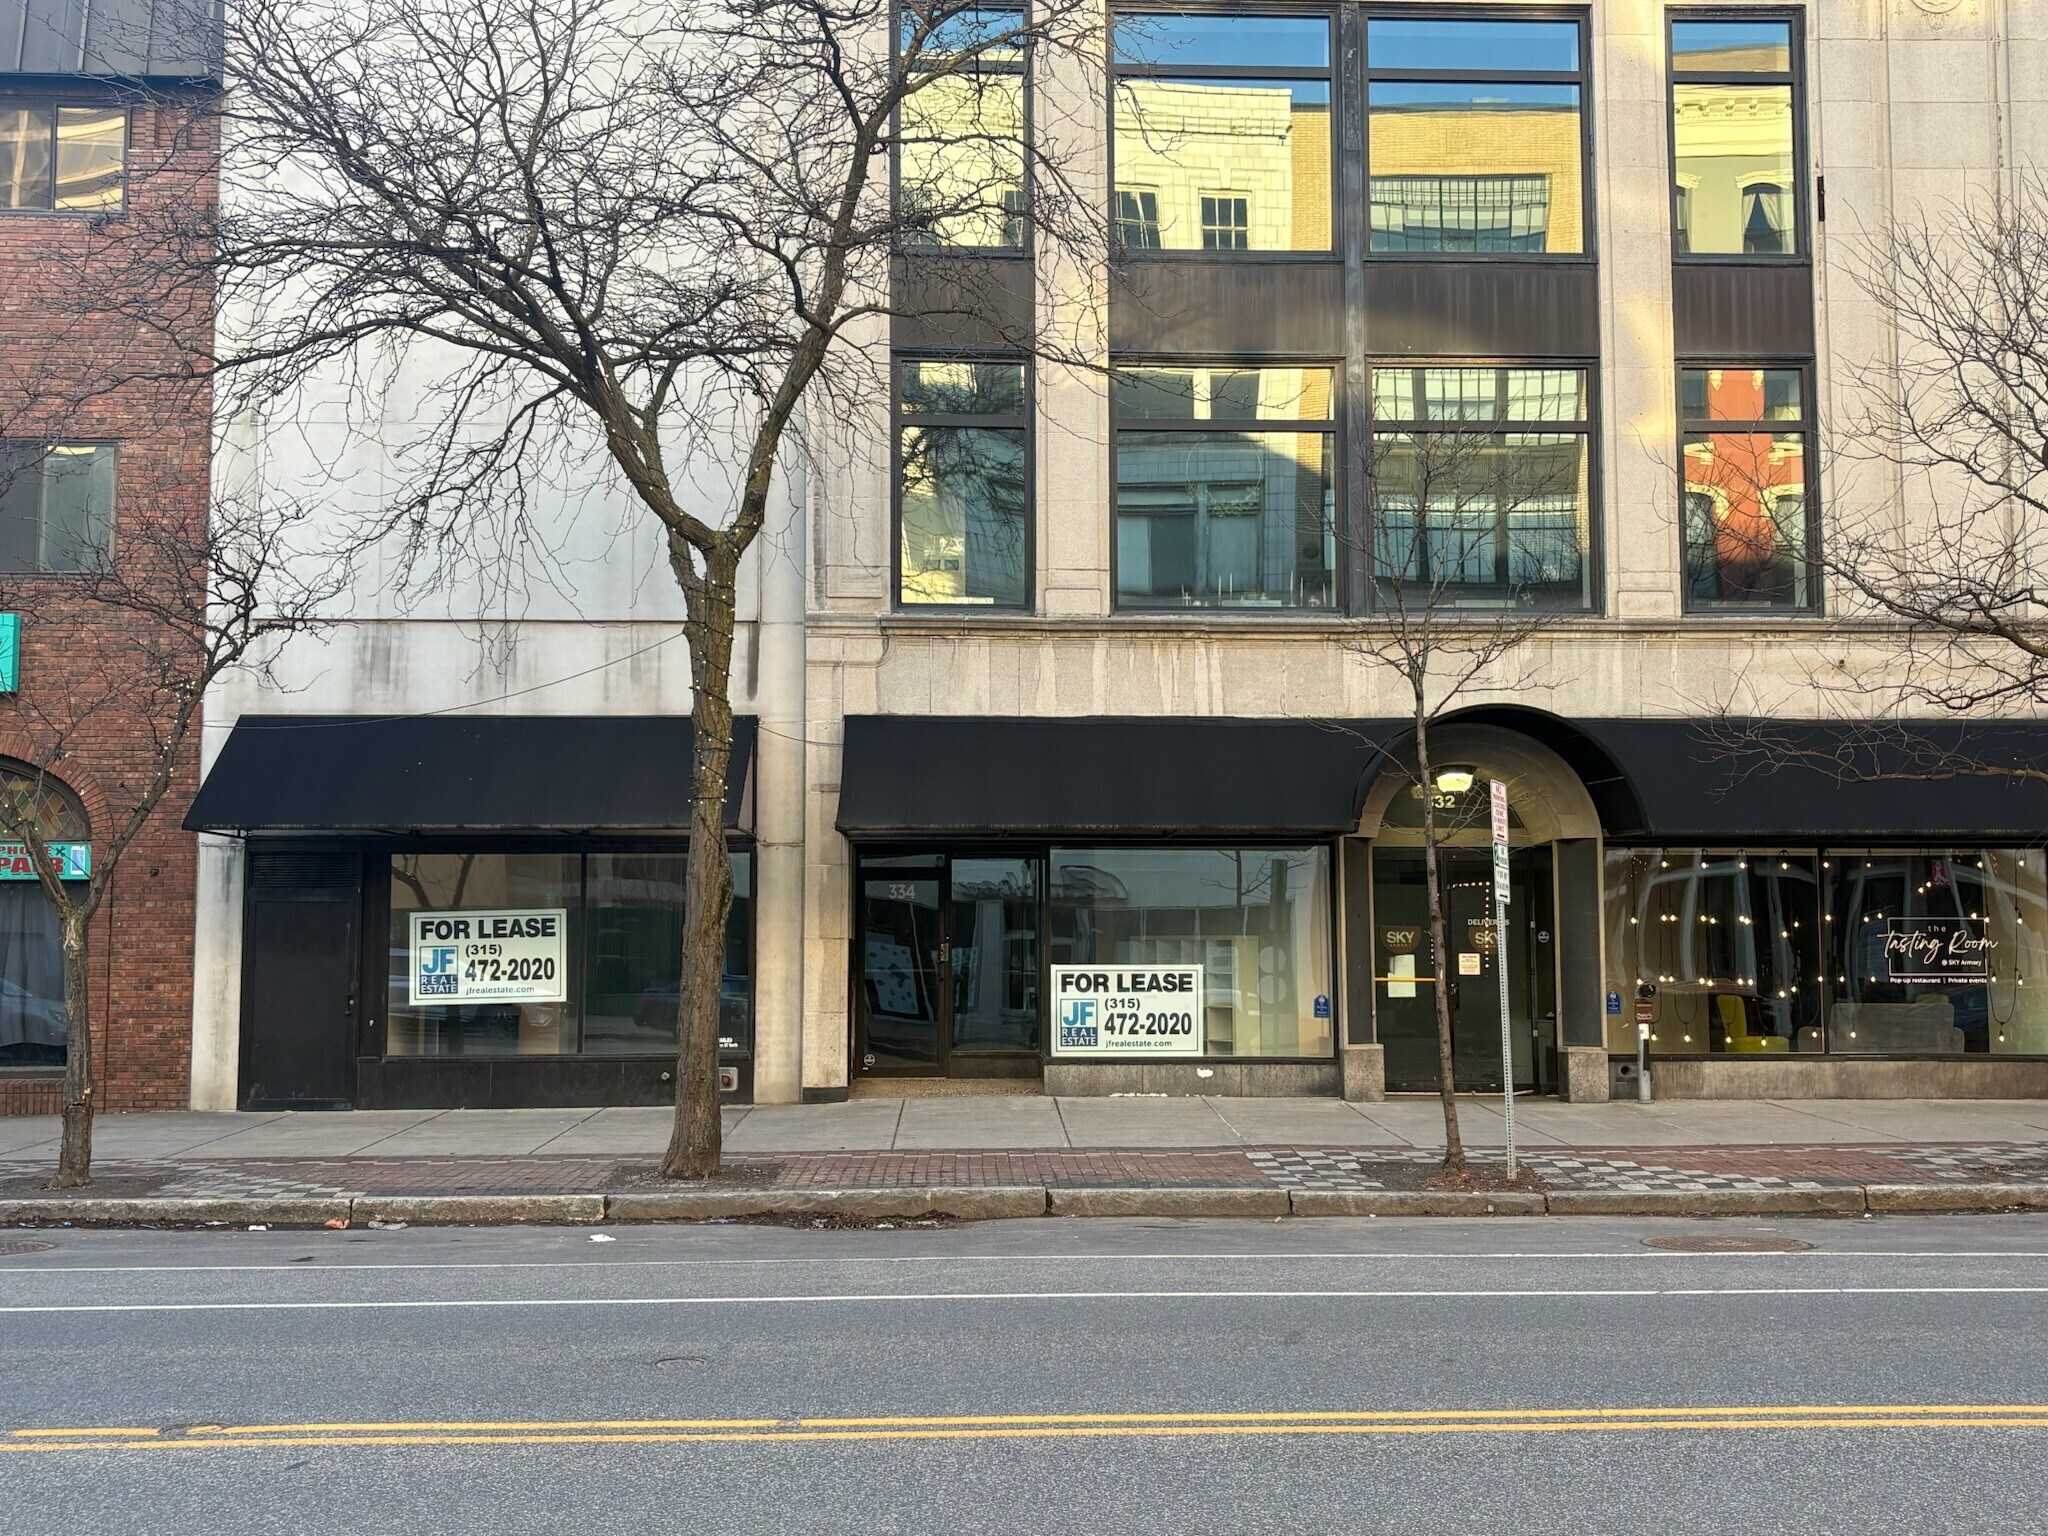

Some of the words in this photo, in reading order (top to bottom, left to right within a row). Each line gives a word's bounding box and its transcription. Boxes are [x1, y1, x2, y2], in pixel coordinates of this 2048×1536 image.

[1431, 795, 1455, 809] 32
[889, 884, 916, 899] 334
[421, 920, 470, 940] FOR
[478, 918, 556, 938] LEASE
[1928, 925, 1947, 933] the
[1387, 931, 1415, 943] SKY
[1949, 930, 1998, 955] Room
[465, 944, 502, 957] (315)
[422, 948, 455, 974] JF
[1961, 959, 1982, 967] Armory
[465, 957, 555, 982] 472-2020
[421, 974, 457, 985] REAL
[1061, 973, 1109, 993] FOR
[1117, 973, 1193, 993] LEASE
[421, 984, 457, 994] ESTATE
[466, 985, 535, 996] jfrealestate.com
[1104, 998, 1141, 1011] (315)
[1063, 1001, 1095, 1026] JF
[1104, 1012, 1192, 1035] 472-2020
[1062, 1028, 1096, 1037] REAL
[1062, 1036, 1097, 1046] ESTATE
[1105, 1040, 1173, 1049] jfrealestate.com
